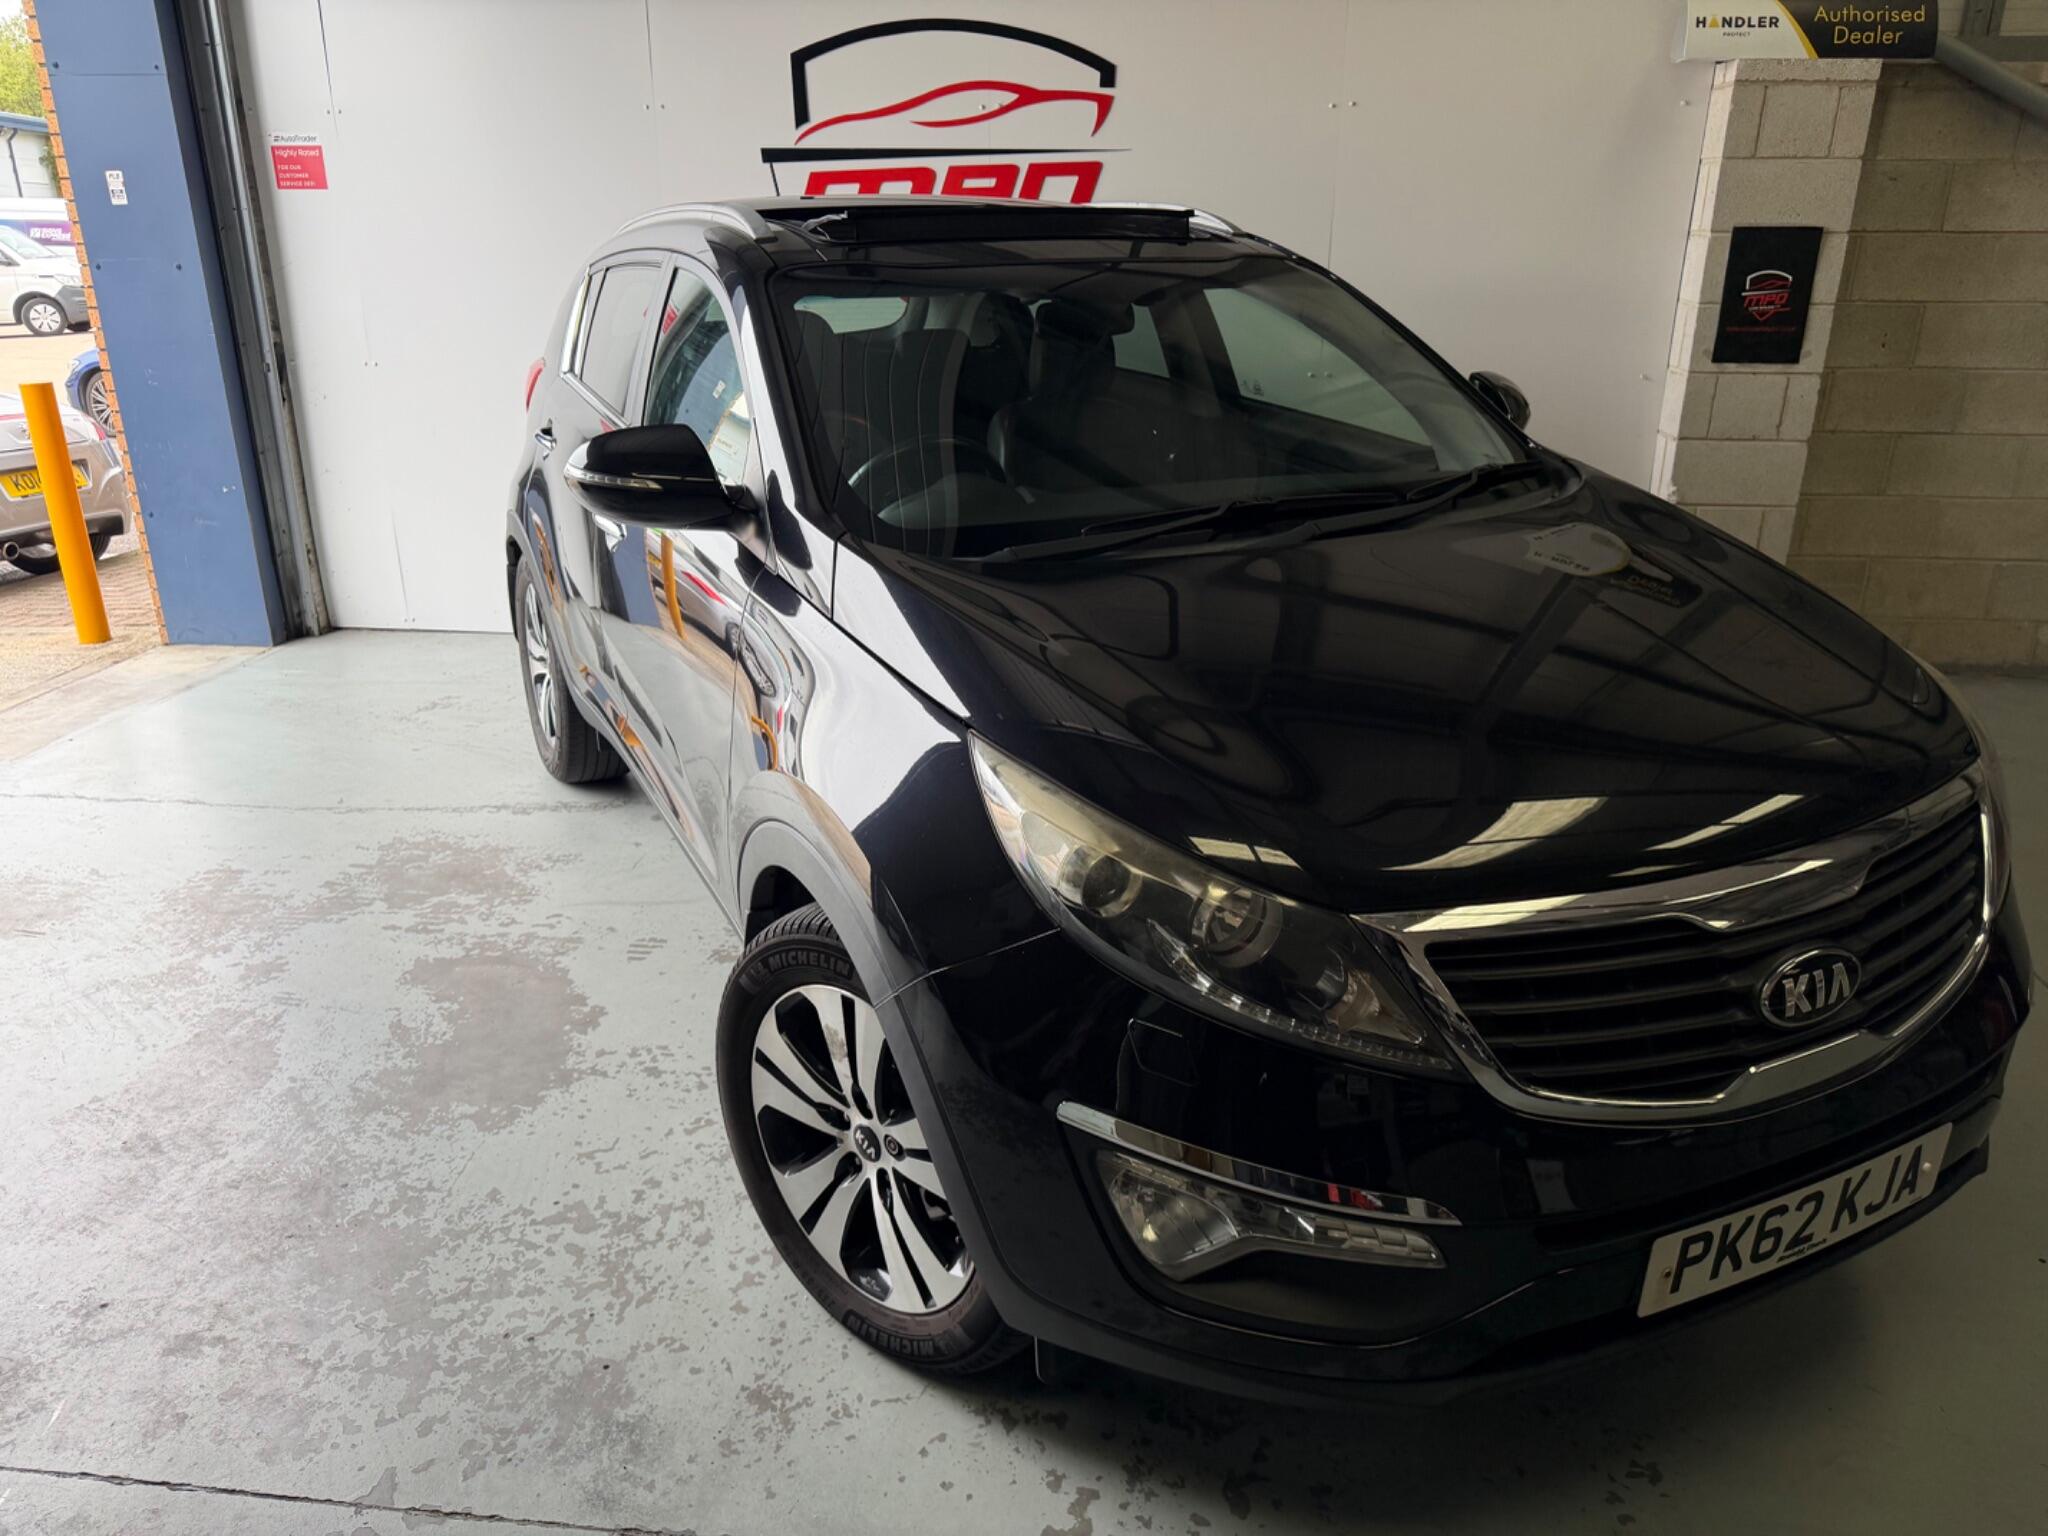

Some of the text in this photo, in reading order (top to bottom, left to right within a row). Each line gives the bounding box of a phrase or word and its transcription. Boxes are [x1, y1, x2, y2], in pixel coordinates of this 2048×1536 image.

[1696, 15, 1780, 29] HANDLER
[1814, 5, 1926, 23] Authorised
[1833, 25, 1904, 45] Dealer
[275, 148, 319, 158] Highly Rated
[767, 951, 851, 978] MICHELIN
[1782, 962, 1851, 1017] KIA
[855, 1128, 876, 1159] KIA
[1669, 1144, 1923, 1294] PK62 KJA
